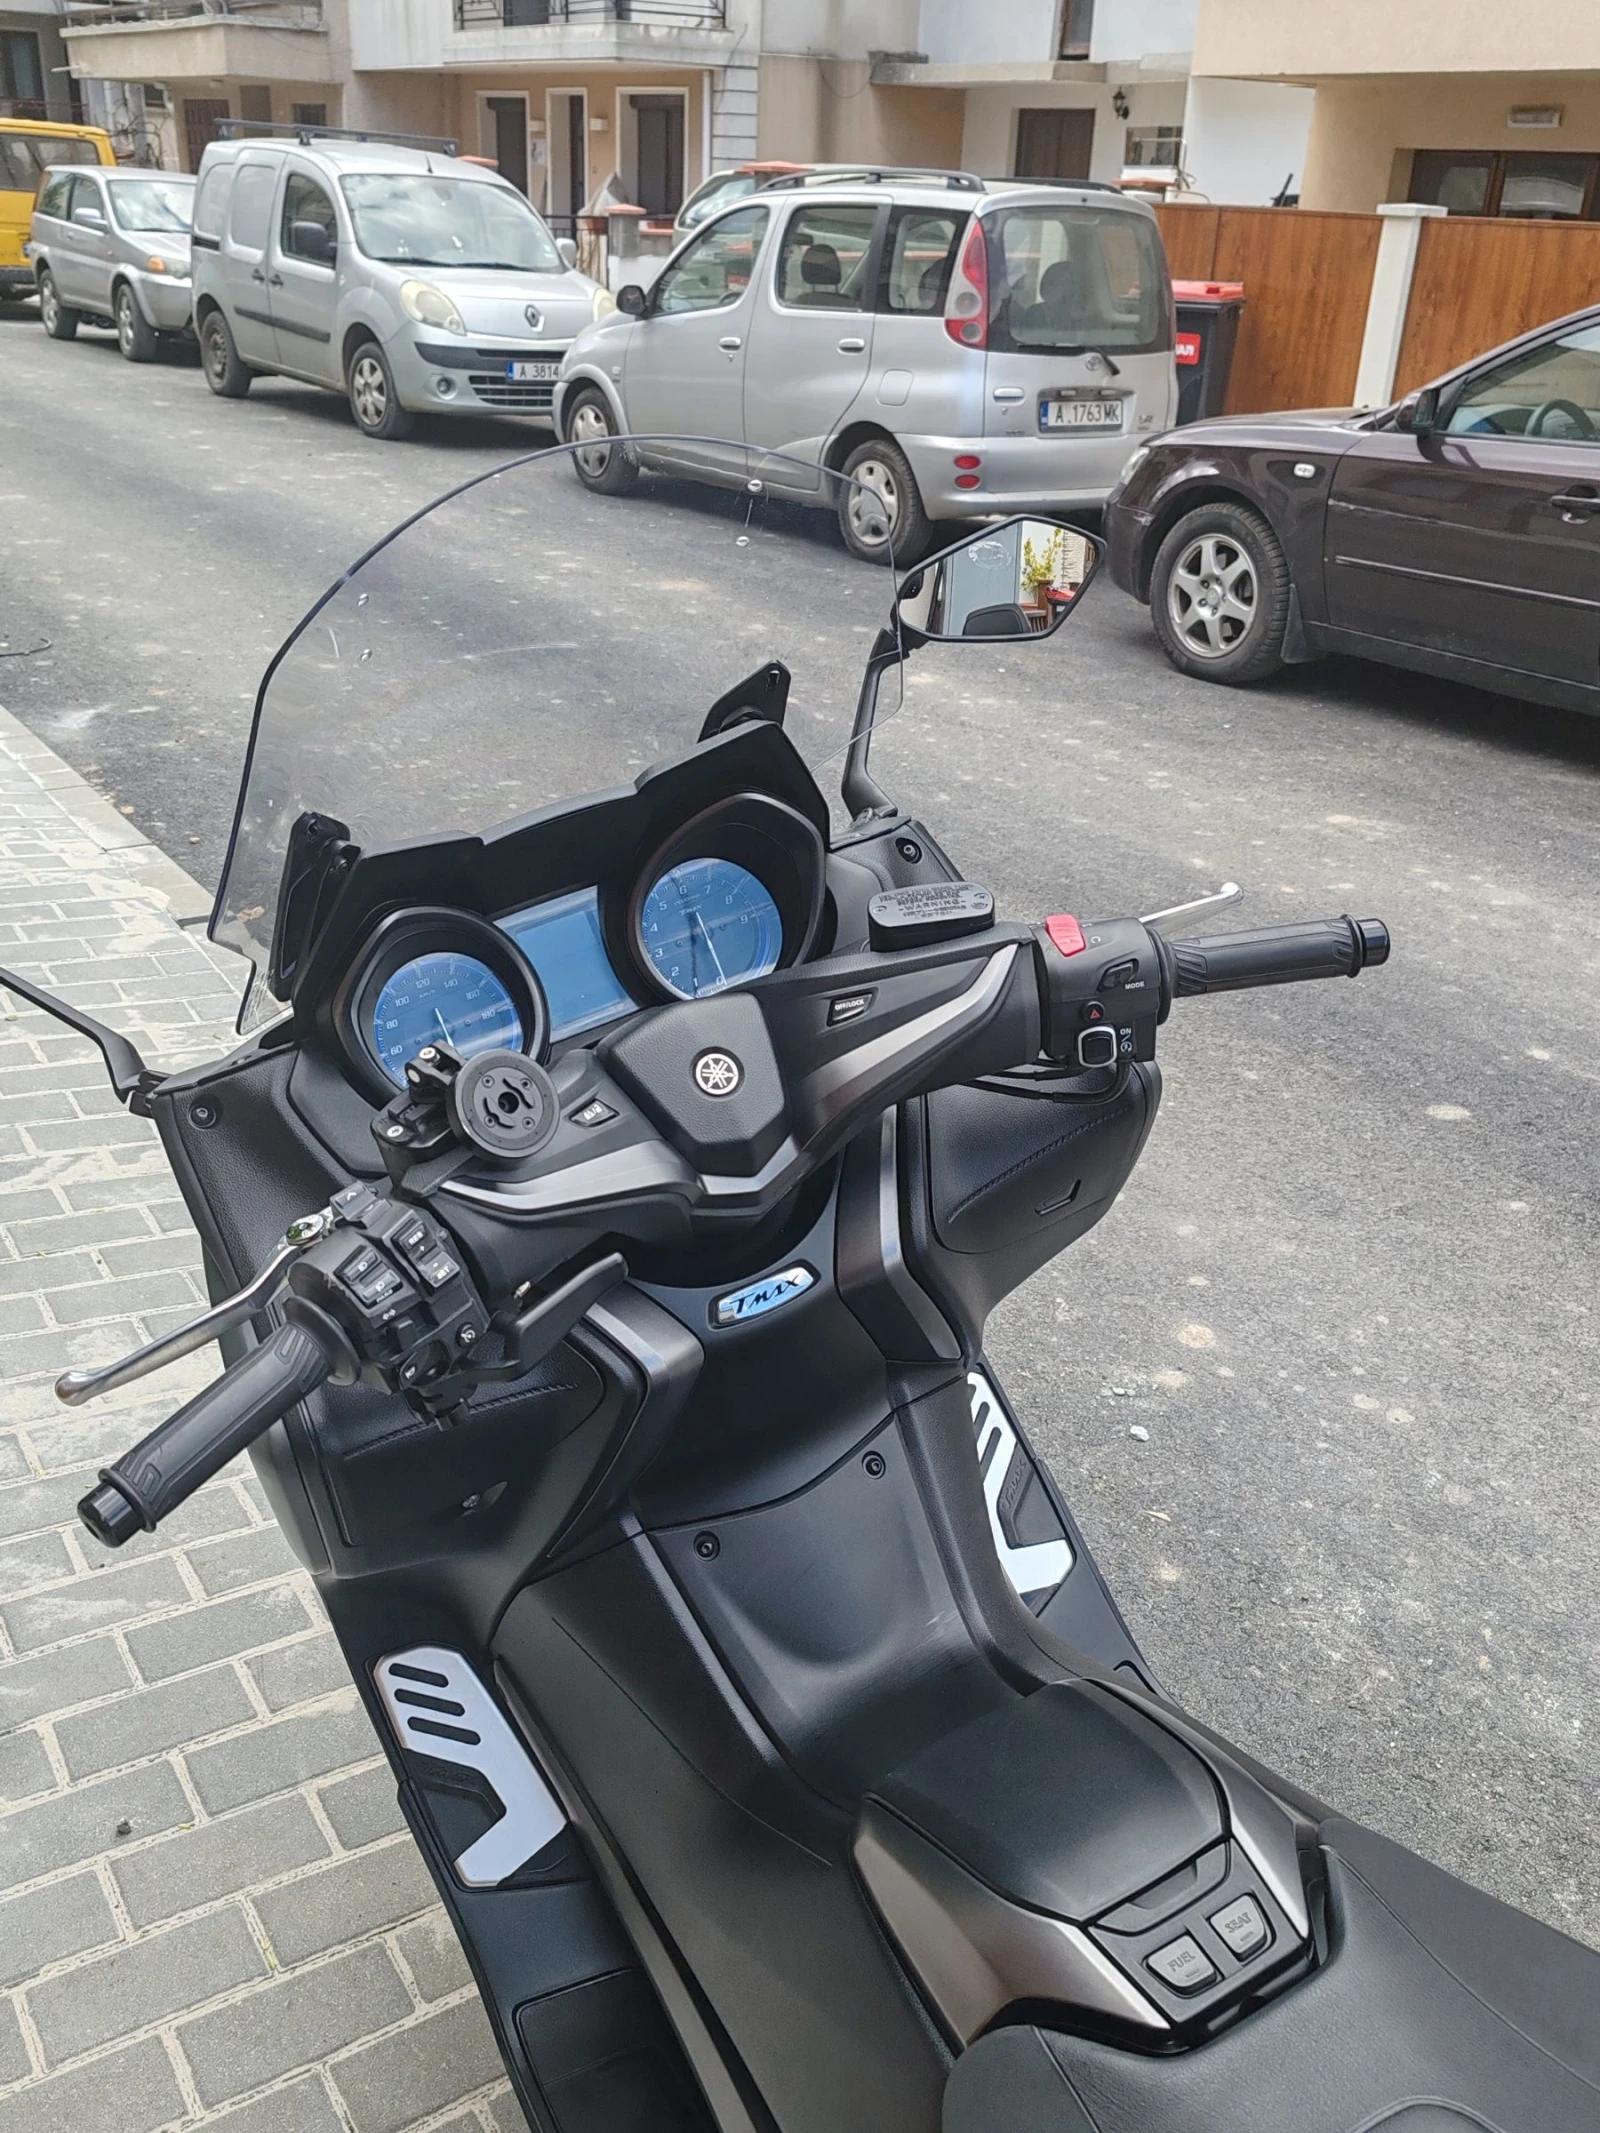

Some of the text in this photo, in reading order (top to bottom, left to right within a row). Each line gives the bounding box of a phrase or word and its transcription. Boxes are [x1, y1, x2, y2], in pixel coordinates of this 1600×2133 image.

[532, 365, 559, 378] 3814
[680, 885, 688, 895] 6
[704, 885, 712, 894] 7
[725, 895, 733, 905] 8
[659, 901, 668, 911] 5
[740, 914, 749, 925] 9
[650, 922, 658, 932] 4
[655, 947, 664, 958] 3
[671, 966, 680, 977] 2
[415, 978, 430, 989] 120
[444, 978, 458, 989] 140
[1124, 981, 1145, 990] MODE
[465, 988, 480, 1000] 160
[395, 995, 410, 1007] 100
[481, 1009, 496, 1020] 180
[386, 1019, 398, 1030] 80
[1120, 1027, 1131, 1035] ON
[390, 1045, 403, 1056] 60
[1224, 1912, 1252, 1934] SEAT
[1167, 1950, 1196, 1973] FUEL
